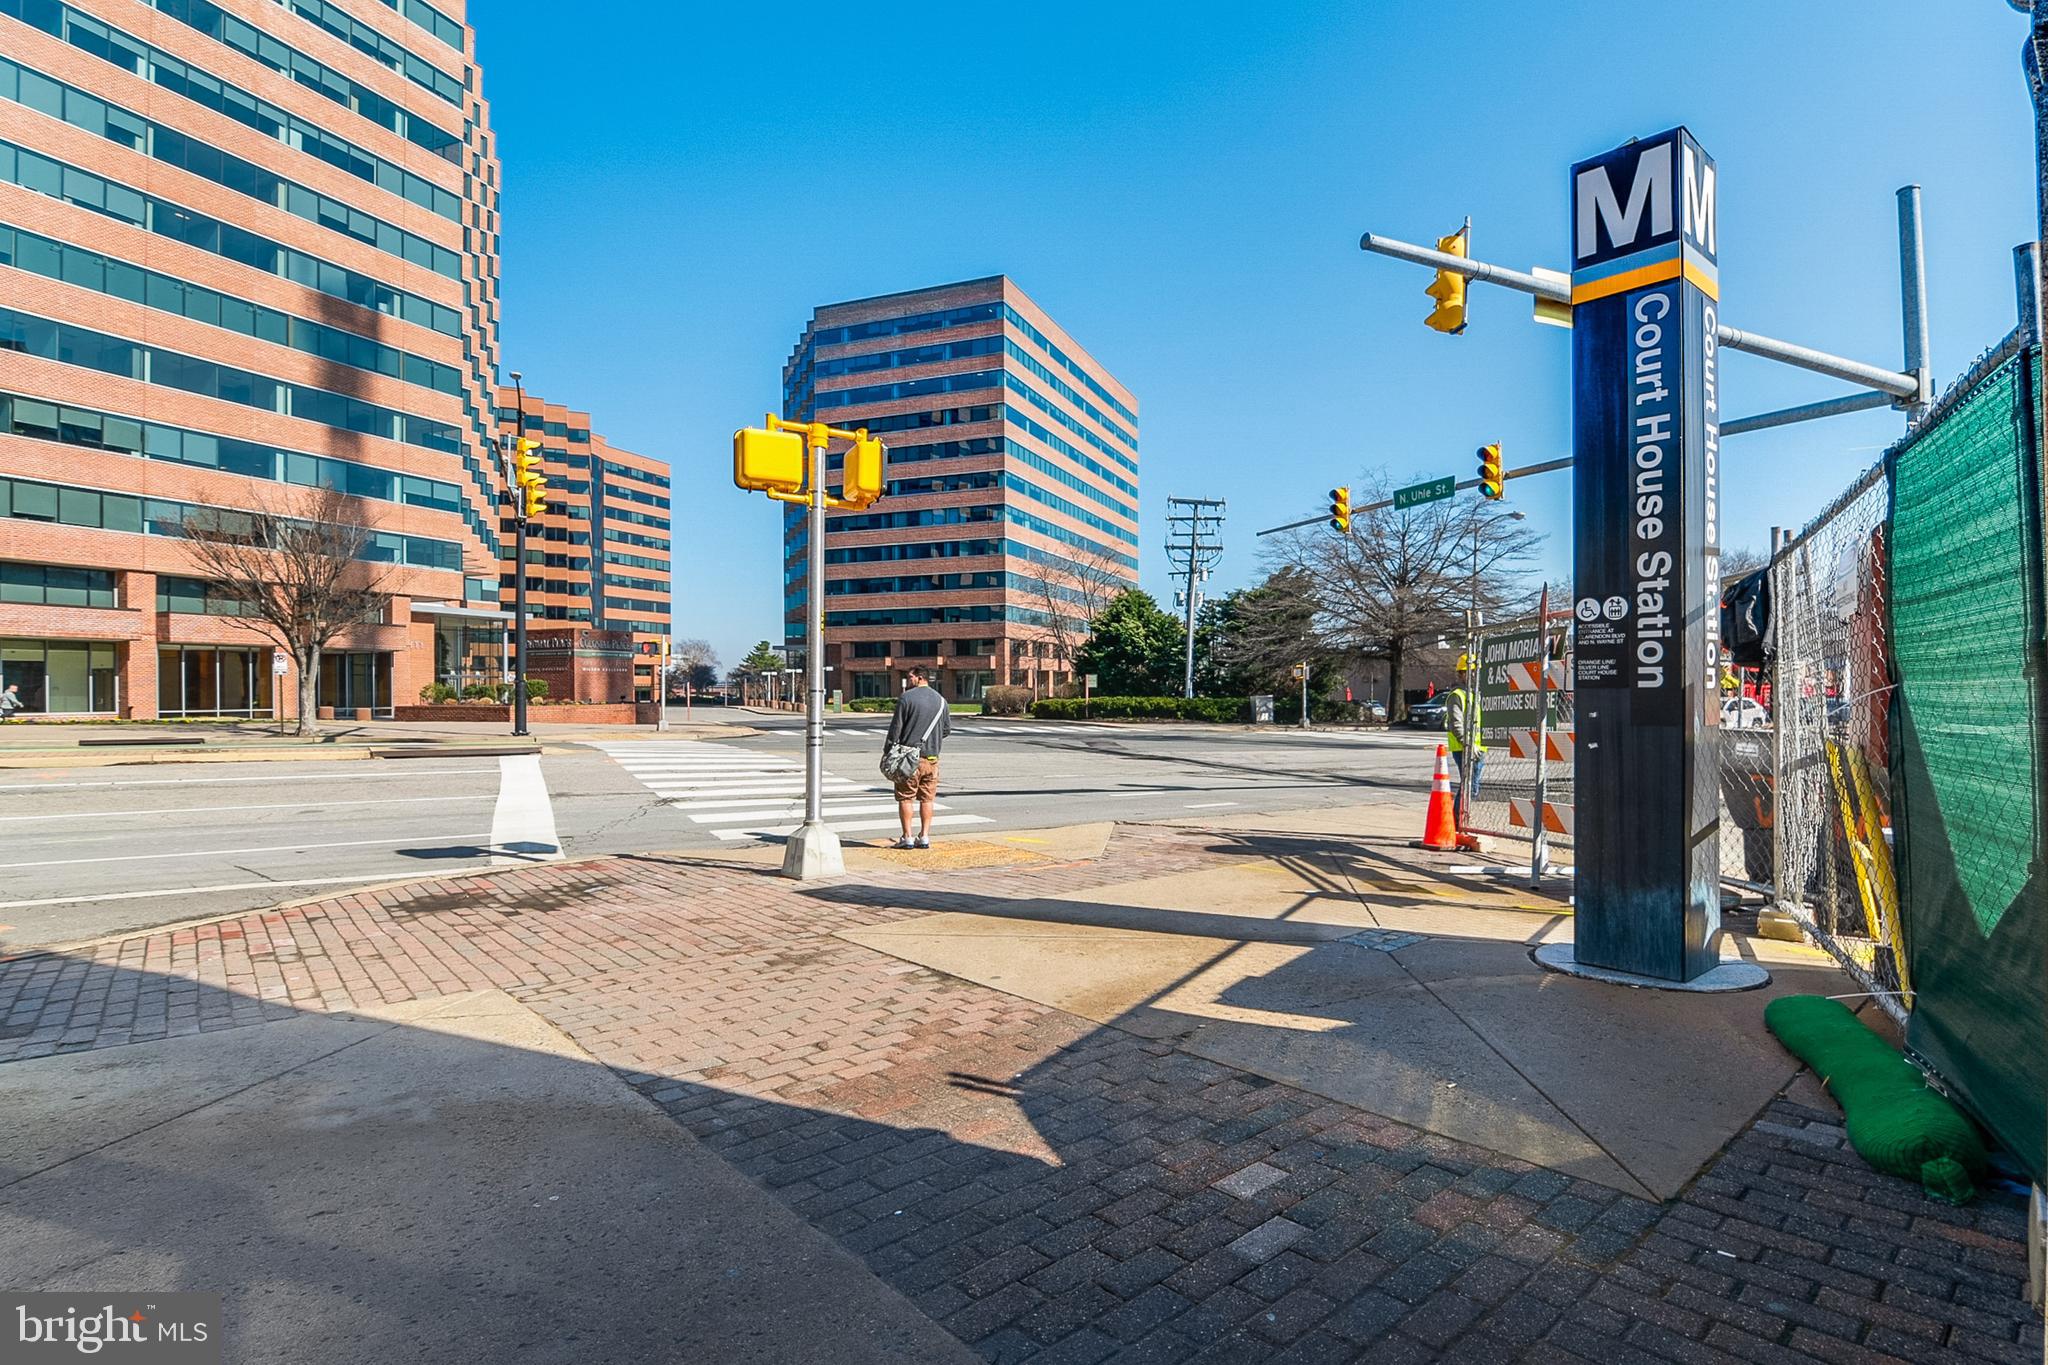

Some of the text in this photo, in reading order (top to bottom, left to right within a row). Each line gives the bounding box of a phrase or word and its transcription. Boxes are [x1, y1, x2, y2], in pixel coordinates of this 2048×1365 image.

[1577, 141, 1673, 259] M
[1684, 143, 1715, 256] M
[1411, 489, 1431, 502] Uhle
[1634, 292, 1672, 689] Court House Station
[1704, 305, 1719, 690] Court House Station
[1482, 694, 1523, 712] COURTHOUSE
[1485, 642, 1507, 664] JOHN
